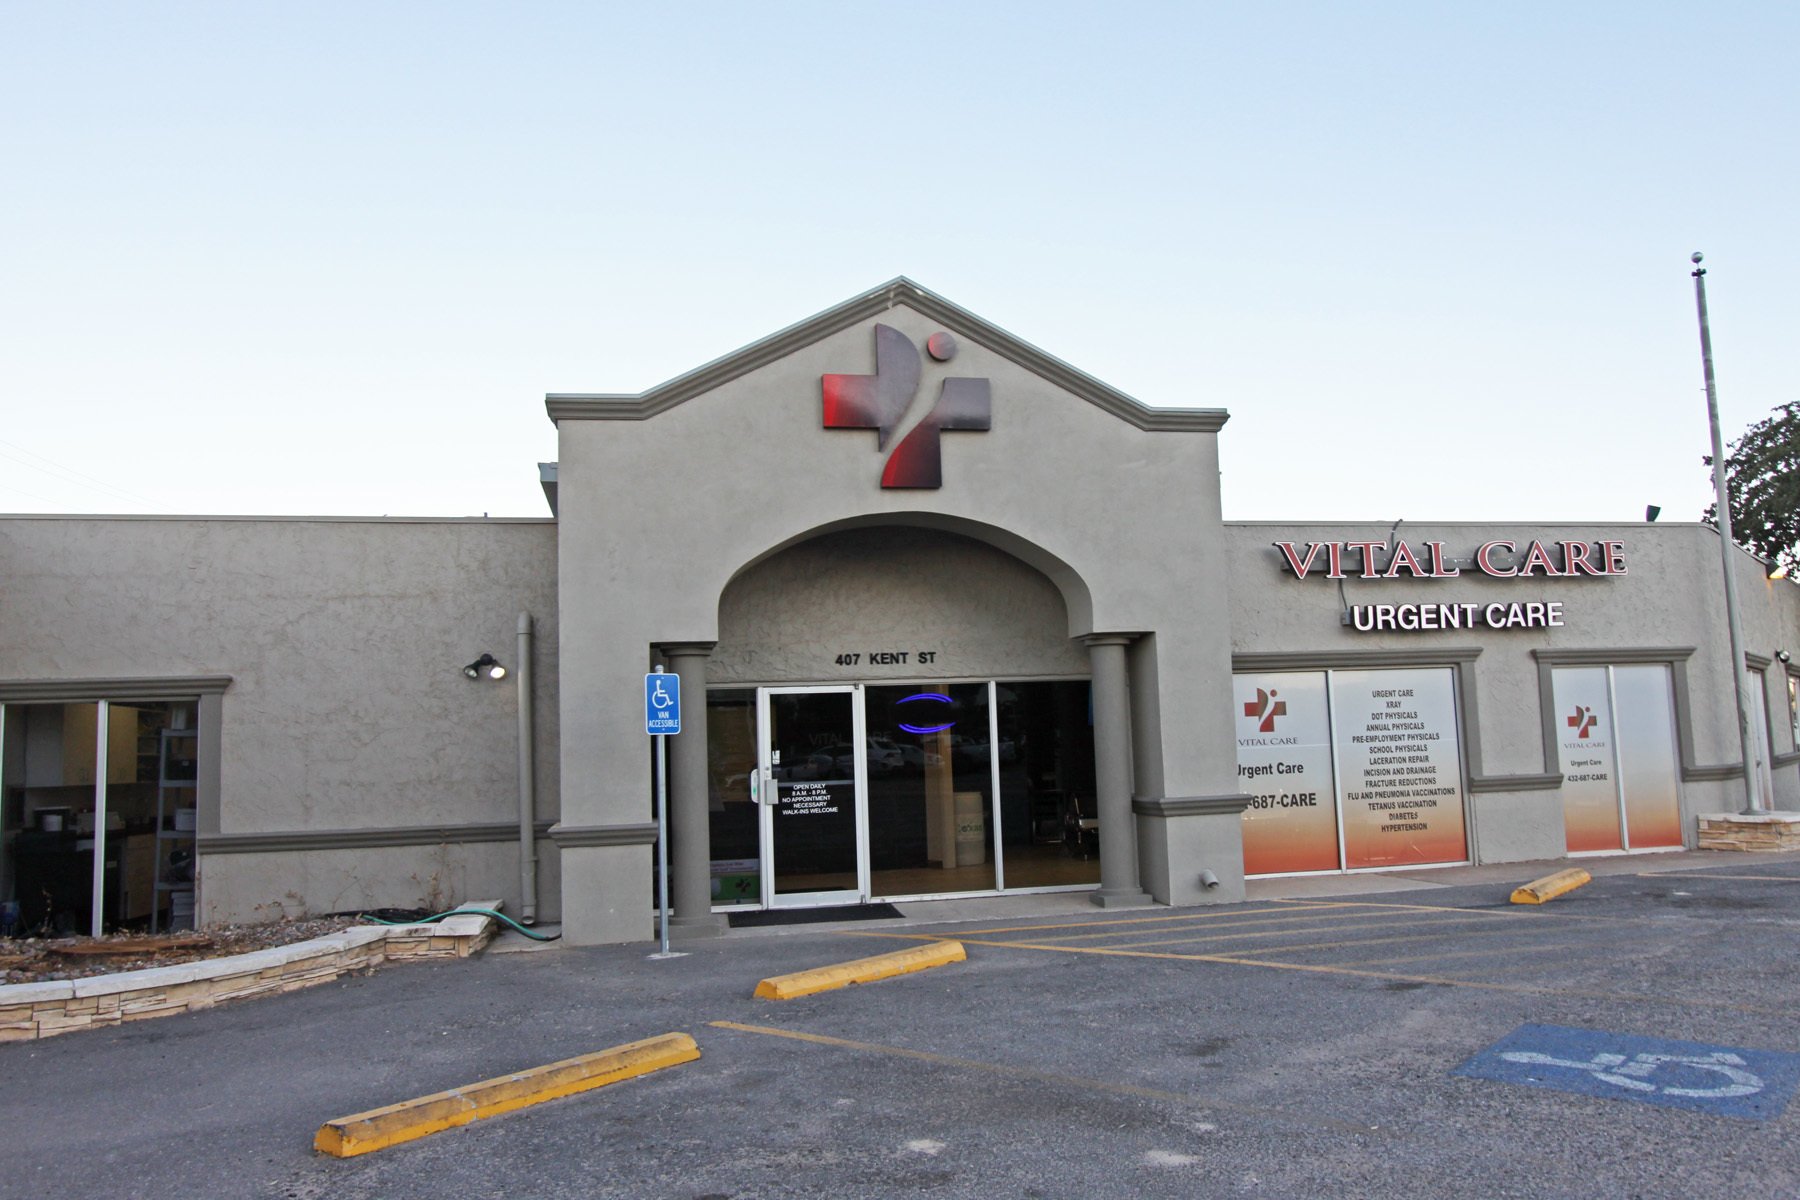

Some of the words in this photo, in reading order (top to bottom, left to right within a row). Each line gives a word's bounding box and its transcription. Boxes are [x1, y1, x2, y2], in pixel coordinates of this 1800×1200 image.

[1274, 540, 1460, 579] VITAL
[1477, 540, 1629, 577] CARE
[1353, 603, 1479, 631] URGENT
[1485, 602, 1565, 628] CARE
[835, 653, 861, 666] 407
[869, 652, 909, 665] KENT
[918, 651, 937, 664] ST
[1372, 690, 1396, 698] URGENT
[1398, 689, 1414, 697] CARE
[1386, 701, 1401, 709] XRAY
[658, 711, 669, 719] VAN
[1371, 712, 1383, 720] DOT
[1385, 711, 1418, 720] PHYSICALS
[649, 720, 678, 728] ACCESSIBLE
[1366, 723, 1391, 732] ANNUAL
[1392, 722, 1425, 731] PHYSICALS
[1238, 738, 1268, 746] VITAL
[1270, 737, 1298, 745] CARE
[1352, 734, 1405, 743] PRE-EMPLOYMENT
[1407, 732, 1440, 741] PHYSICALS
[1369, 745, 1394, 754] SCHOOL
[1395, 744, 1428, 753] PHYSICALS
[1369, 756, 1407, 765] LACERATION
[1408, 755, 1429, 763] REPAIR
[1571, 760, 1588, 768] Urgent
[1277, 762, 1304, 774] Care
[1364, 768, 1391, 777] INCISION
[1392, 768, 1405, 776] AND
[1406, 766, 1437, 775] DRAINAGE
[1365, 779, 1397, 788] FRACTURE
[1398, 777, 1437, 786] REDUCTIONS
[1568, 774, 1608, 782] 432-687-CARE
[1348, 792, 1360, 800] FLU
[1361, 791, 1374, 799] AND
[1375, 790, 1410, 799] PNEUMONIA
[1411, 788, 1455, 797] VACCINATIONS
[1245, 793, 1317, 809] -687-CARE
[1368, 802, 1396, 811] TETANUS
[1397, 800, 1437, 809] VACCINATION
[1389, 812, 1418, 821] DIABETES
[1381, 823, 1428, 832] HYPERTENSION
